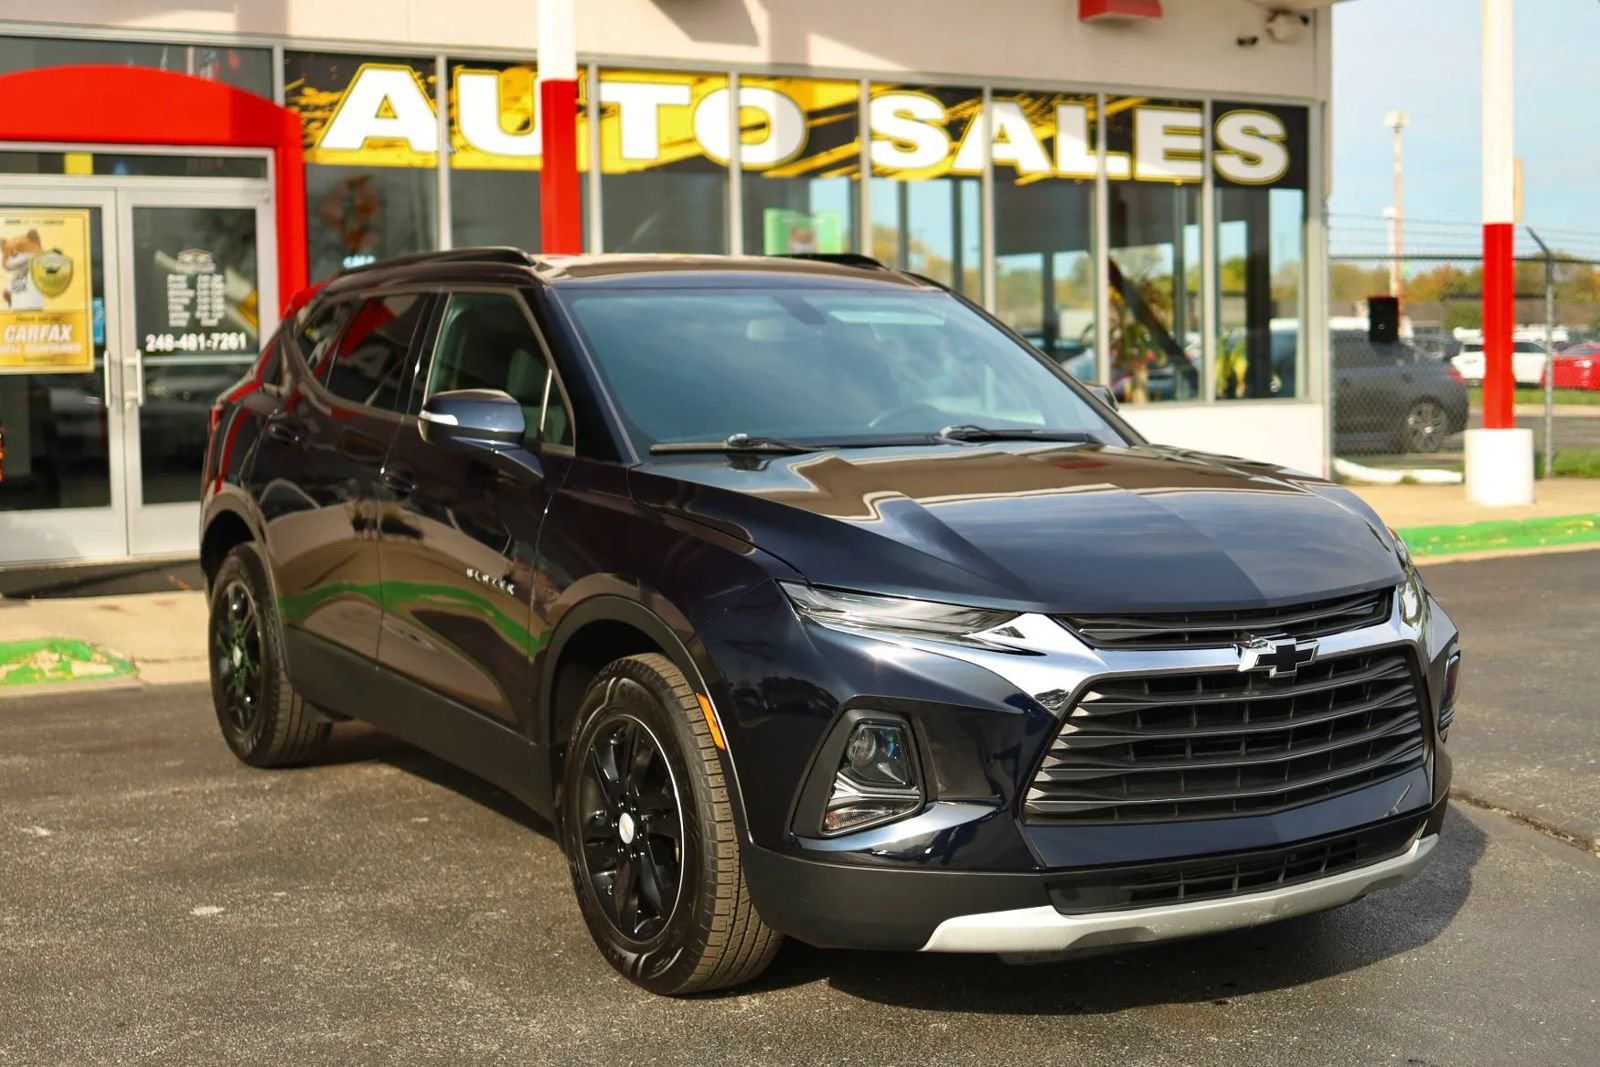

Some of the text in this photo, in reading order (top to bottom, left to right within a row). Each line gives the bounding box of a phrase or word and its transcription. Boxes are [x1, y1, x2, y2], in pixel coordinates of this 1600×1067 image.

[317, 65, 1289, 183] AUTO SALES
[4, 324, 73, 344] CARFAX
